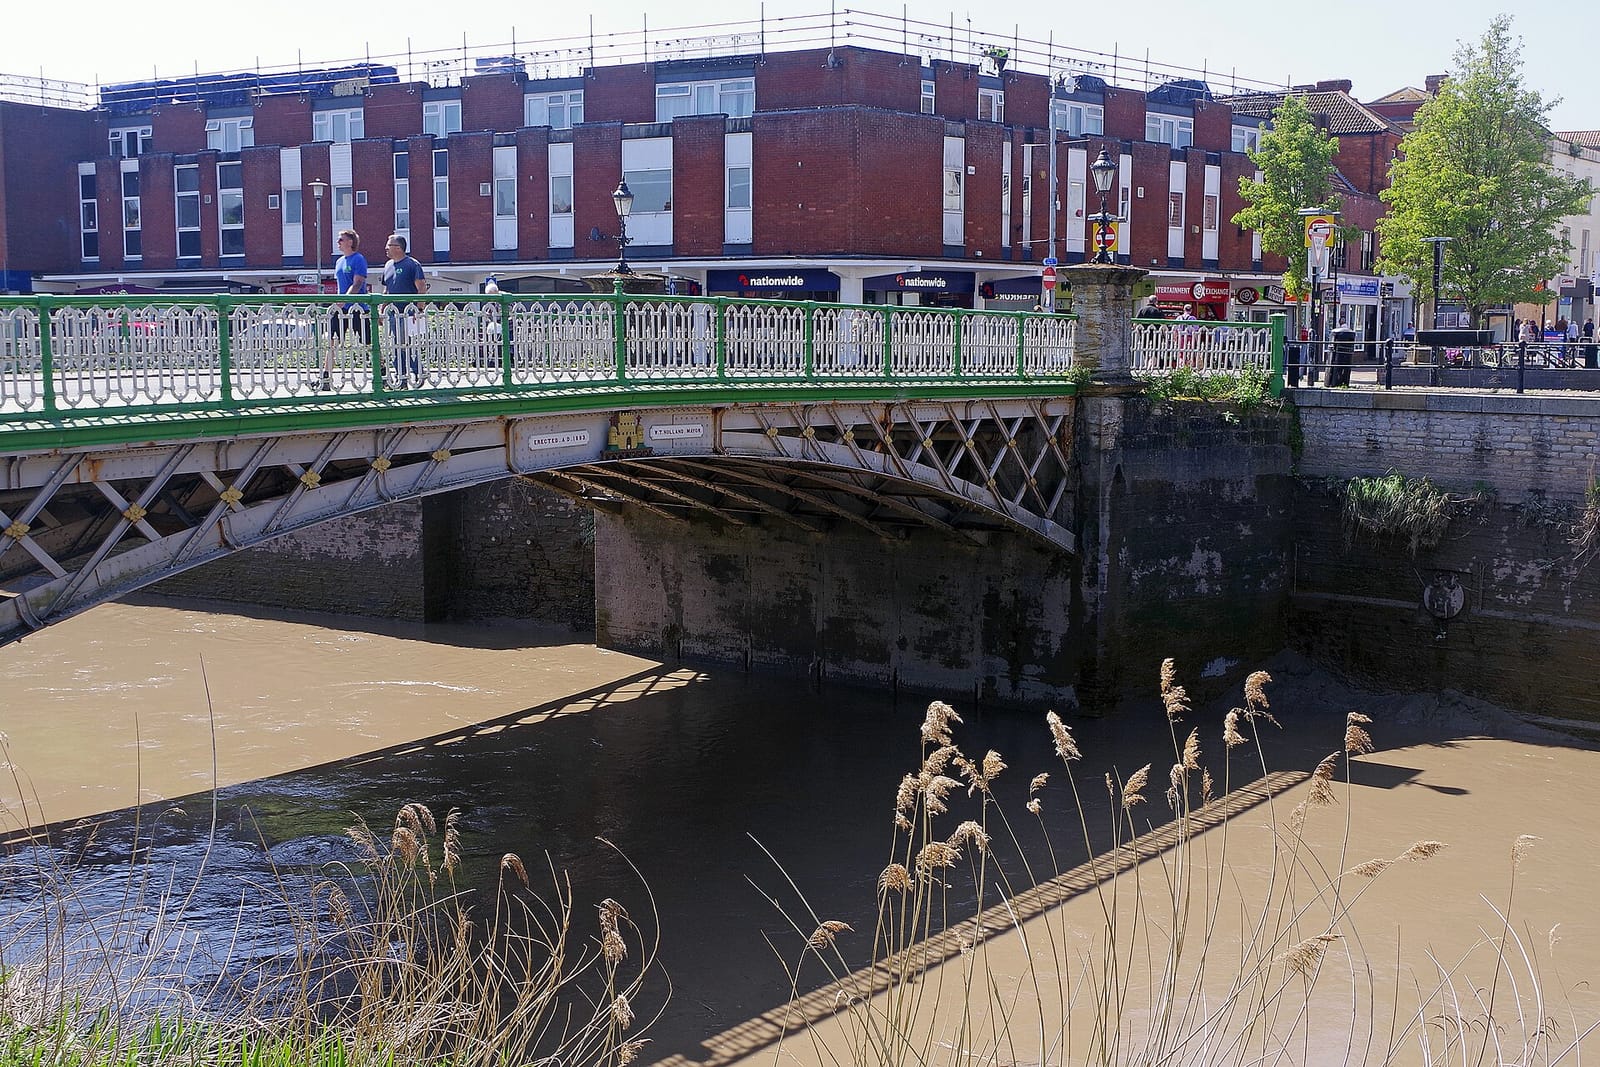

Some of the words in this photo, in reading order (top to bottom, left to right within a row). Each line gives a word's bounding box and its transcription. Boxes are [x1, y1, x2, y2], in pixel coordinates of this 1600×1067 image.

[750, 275, 803, 286] nationwide
[905, 277, 946, 287] nationwide
[1155, 286, 1190, 295] NTERTAINMENT
